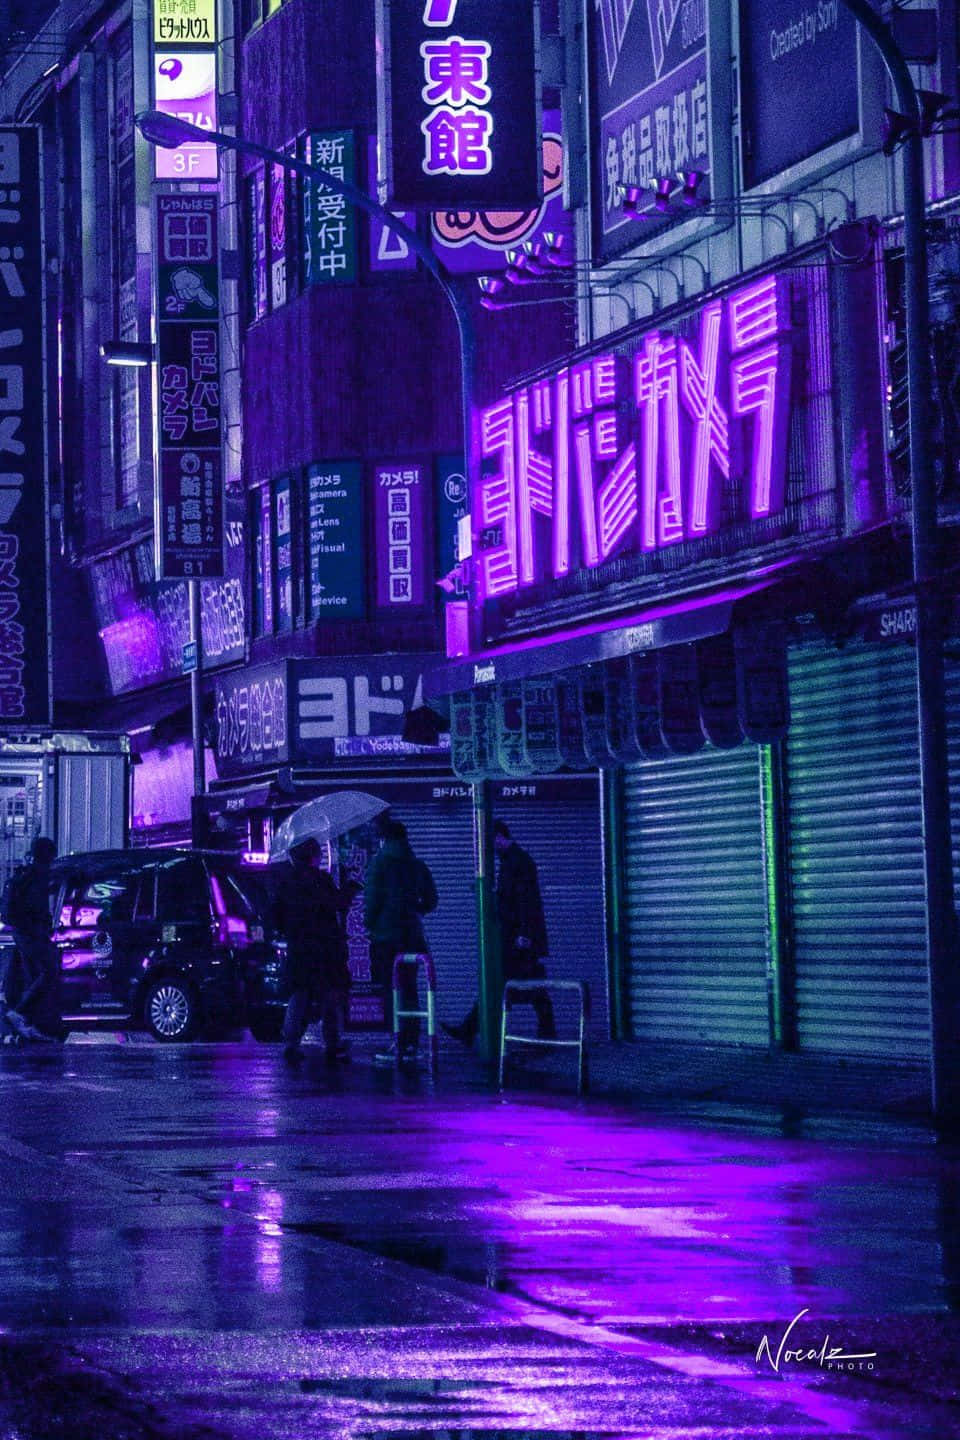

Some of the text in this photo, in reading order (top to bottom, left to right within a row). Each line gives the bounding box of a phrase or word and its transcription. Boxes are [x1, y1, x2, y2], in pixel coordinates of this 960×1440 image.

[158, 17, 210, 39] ピタットハウス
[173, 153, 201, 172] 3F
[604, 78, 708, 210] 免税品取扱店
[165, 295, 186, 313] 2F
[162, 364, 188, 441] カメラ
[190, 330, 219, 433] ヨドバシ
[379, 470, 419, 486] カメラ!
[390, 490, 410, 600] 高価買取
